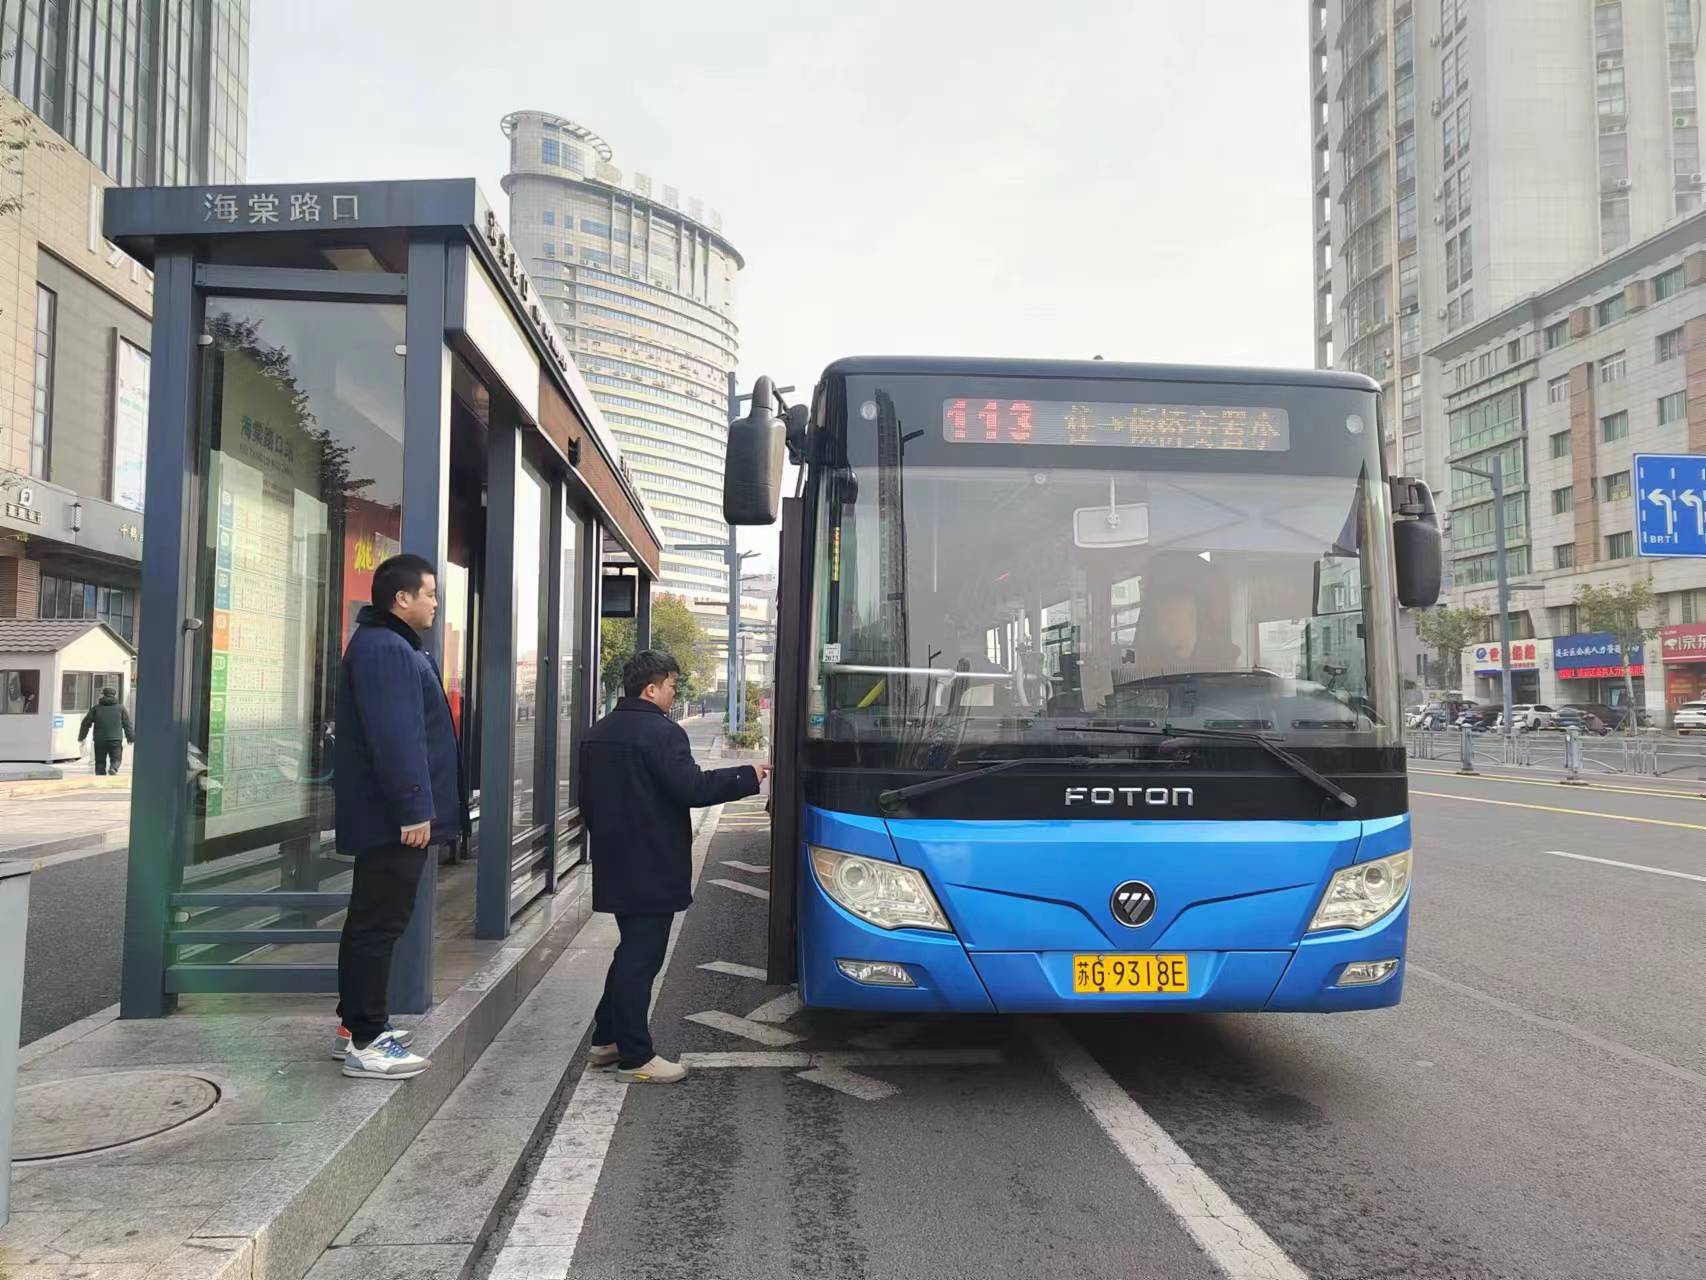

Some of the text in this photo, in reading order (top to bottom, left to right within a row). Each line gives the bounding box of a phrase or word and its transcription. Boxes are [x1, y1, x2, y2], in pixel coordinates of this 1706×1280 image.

[203, 192, 359, 224] 海棠路口
[946, 400, 1033, 440] 113
[1650, 535, 1671, 544] BRT
[1064, 787, 1194, 806] FOTON
